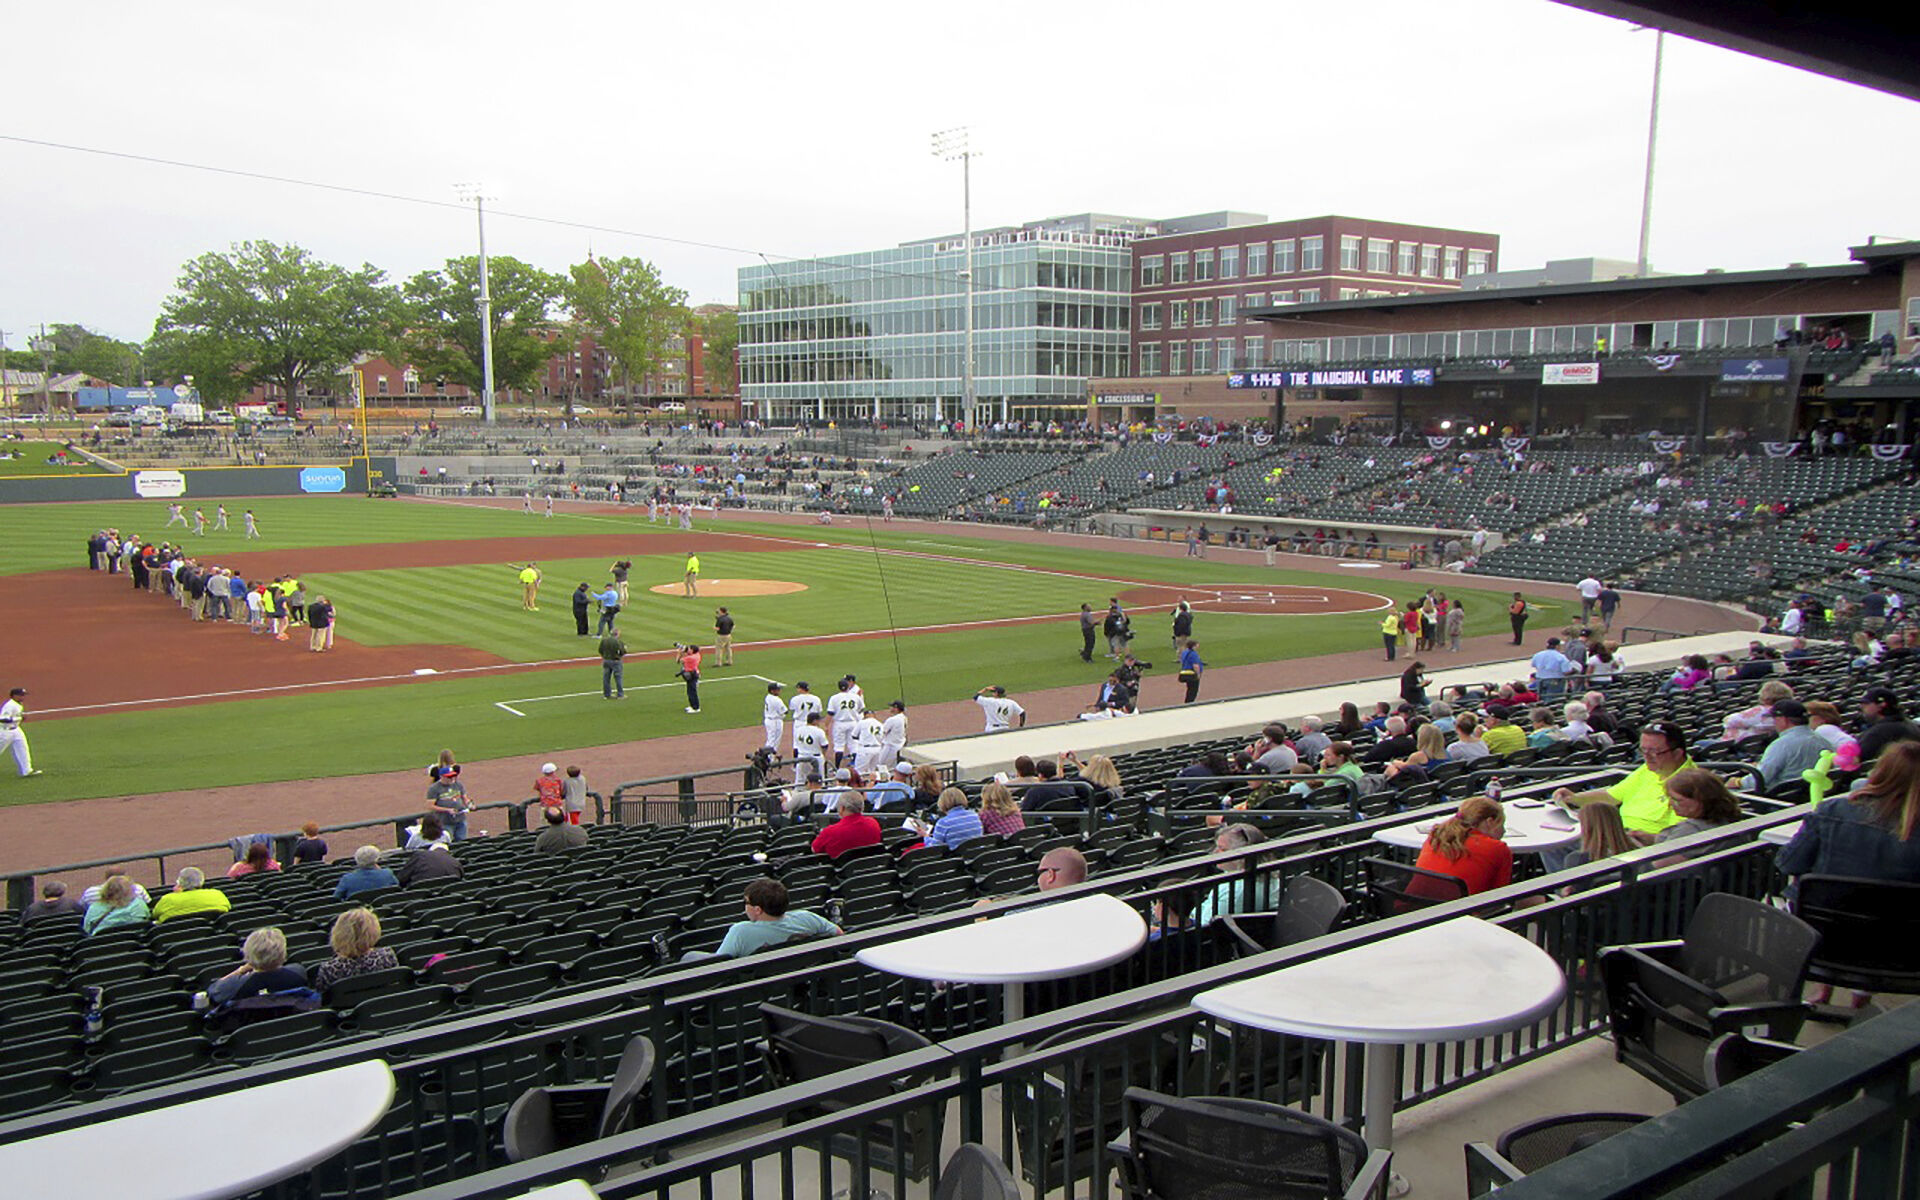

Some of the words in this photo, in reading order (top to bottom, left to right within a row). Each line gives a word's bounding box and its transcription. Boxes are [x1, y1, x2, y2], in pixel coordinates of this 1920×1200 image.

[1290, 371, 1309, 386] THE
[1311, 370, 1368, 385] INAUGURAL
[1371, 369, 1403, 384] GAME
[801, 701, 814, 711] 17
